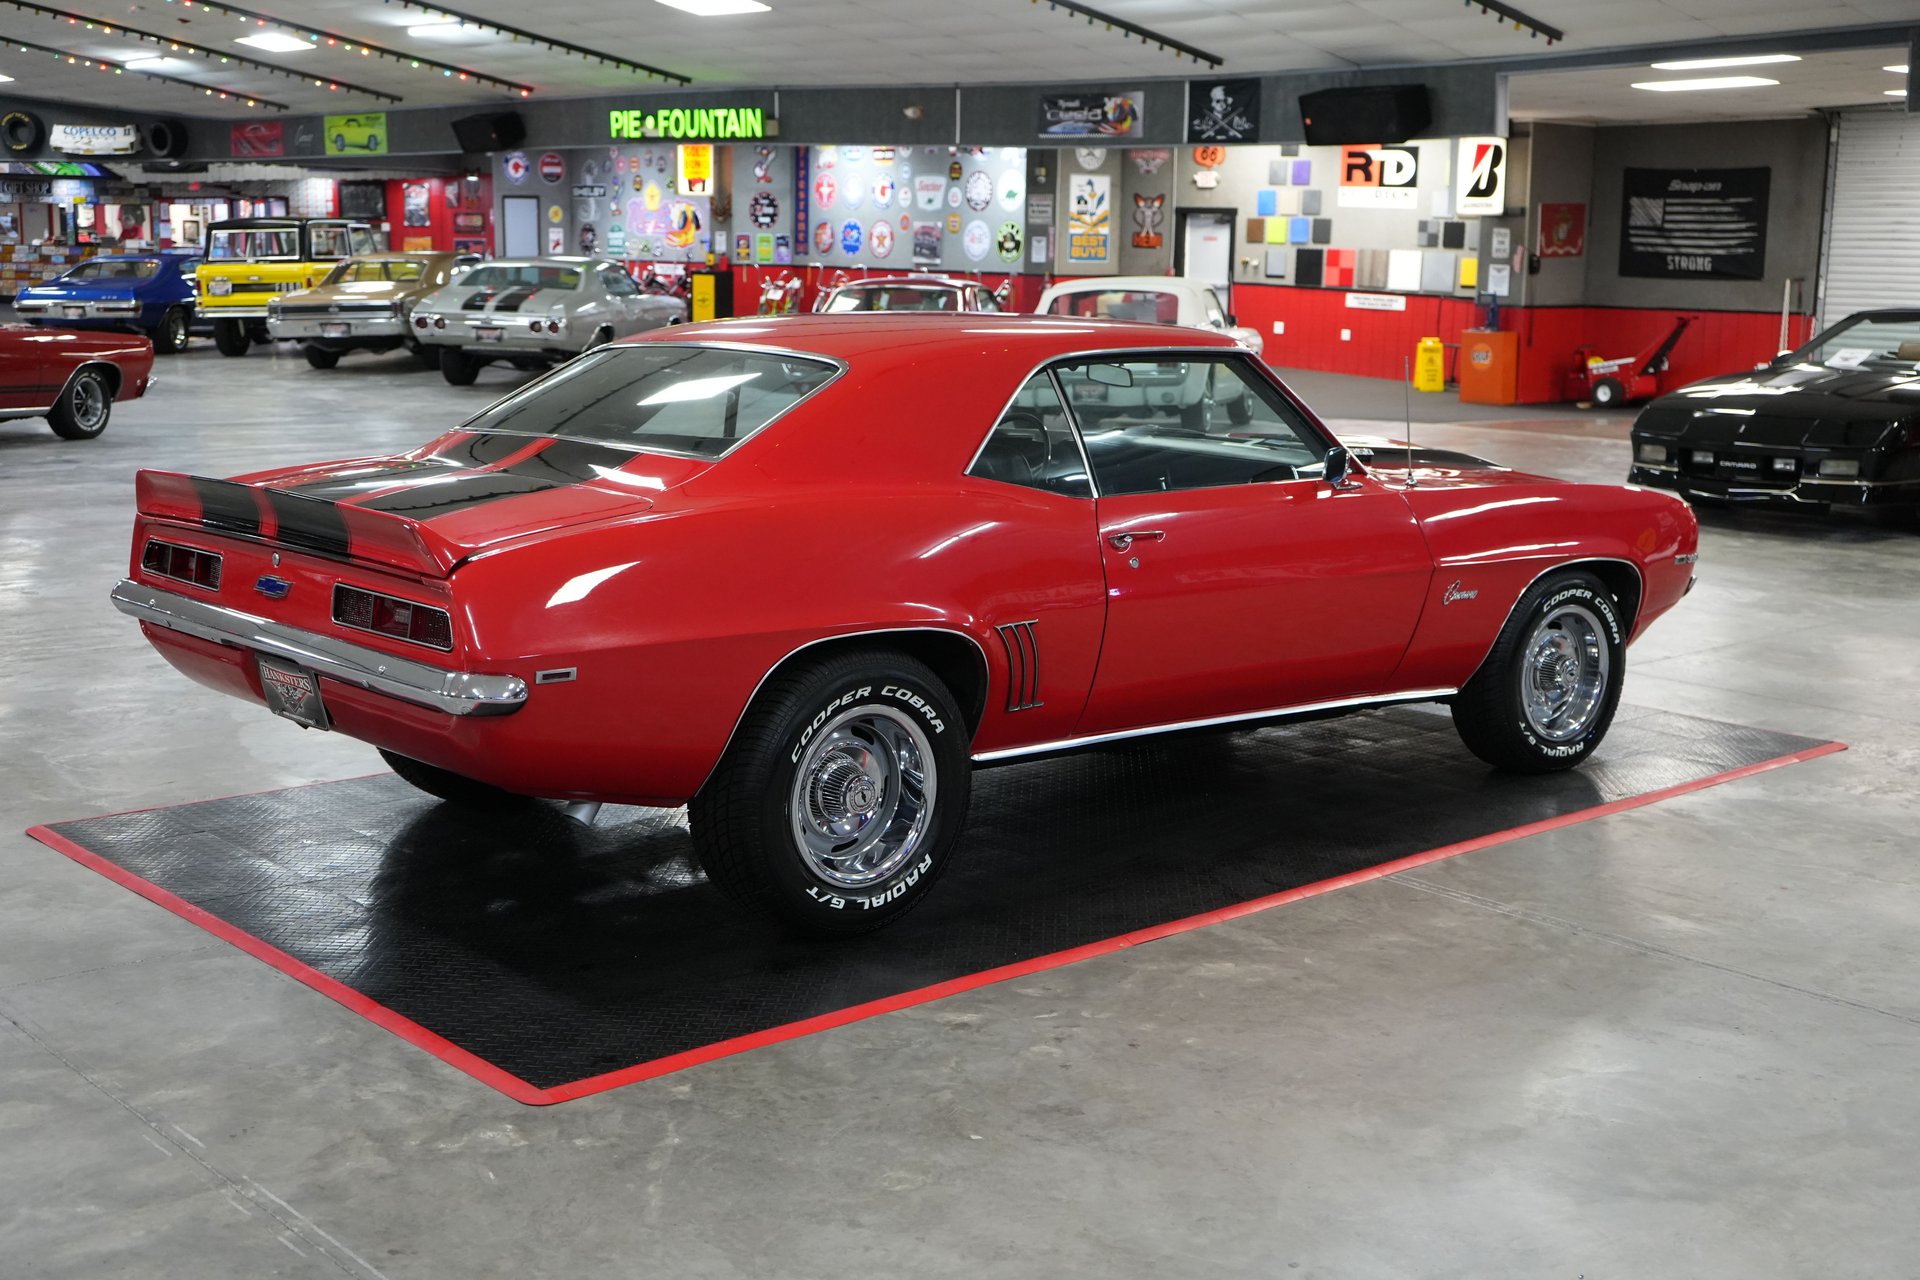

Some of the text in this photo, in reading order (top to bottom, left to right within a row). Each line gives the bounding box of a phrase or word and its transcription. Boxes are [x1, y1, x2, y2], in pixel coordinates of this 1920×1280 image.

[63, 127, 117, 137] COPELCO
[609, 108, 763, 138] PIE FOUNTAIN
[1201, 147, 1219, 161] 66
[1667, 179, 1723, 193] Snap-on
[1071, 235, 1106, 247] BEST
[1070, 246, 1106, 258] BUYS
[1666, 255, 1713, 272] STRONG
[1720, 460, 1757, 470] CAMARO
[1443, 579, 1479, 606] Camaro
[1543, 588, 1621, 645] COOPER COBRA
[262, 666, 312, 691] HANKSTERS
[791, 685, 945, 764] COOPER COBRA
[1518, 721, 1585, 758] RADIAL G/T
[805, 853, 933, 910] RADIAL G/T
